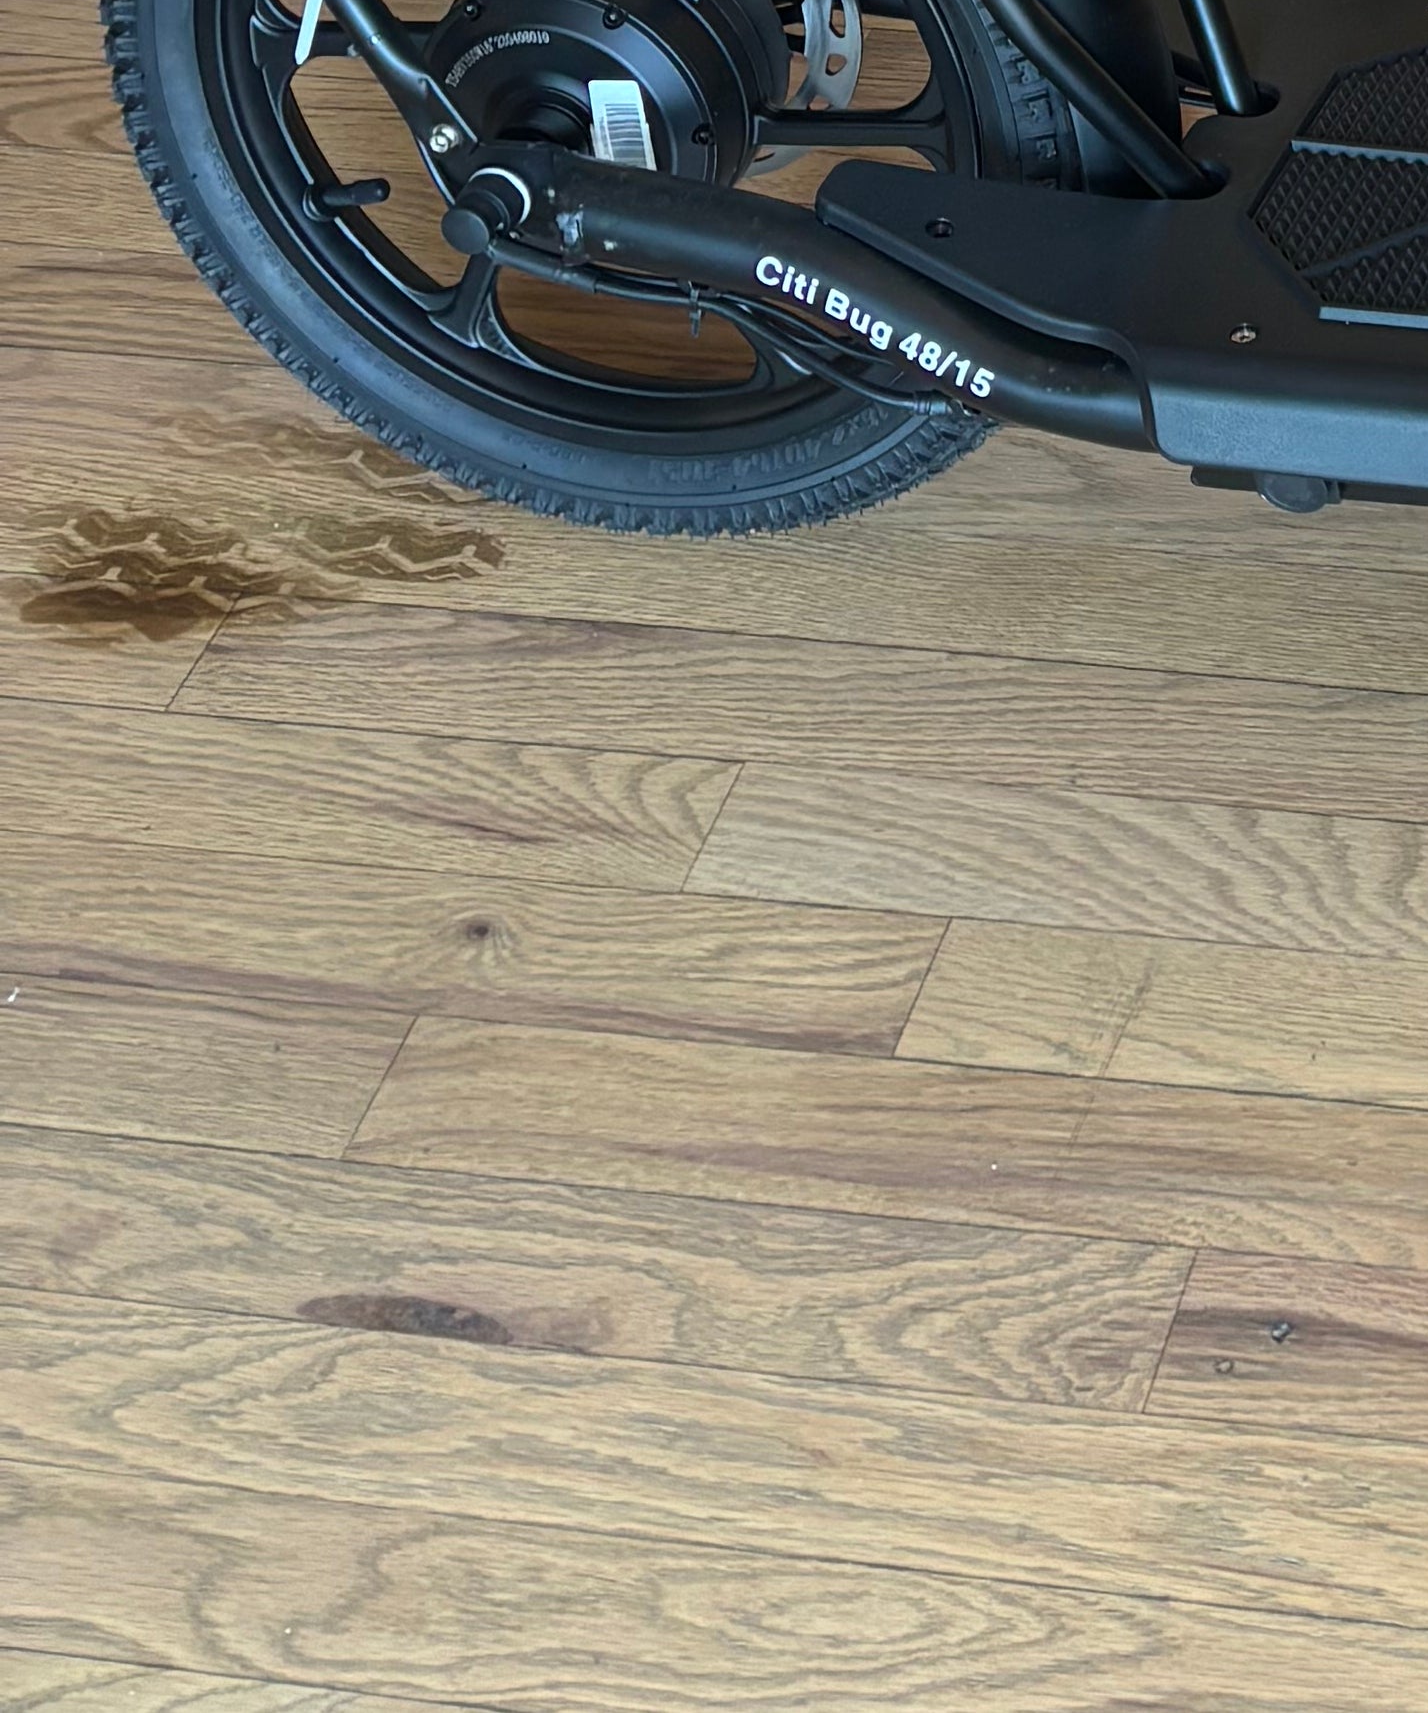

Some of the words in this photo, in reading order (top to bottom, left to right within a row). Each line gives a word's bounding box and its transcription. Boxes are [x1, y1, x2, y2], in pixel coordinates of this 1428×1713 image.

[756, 255, 820, 305] Citi
[824, 287, 894, 351] Bug
[898, 332, 996, 399] 48/15
